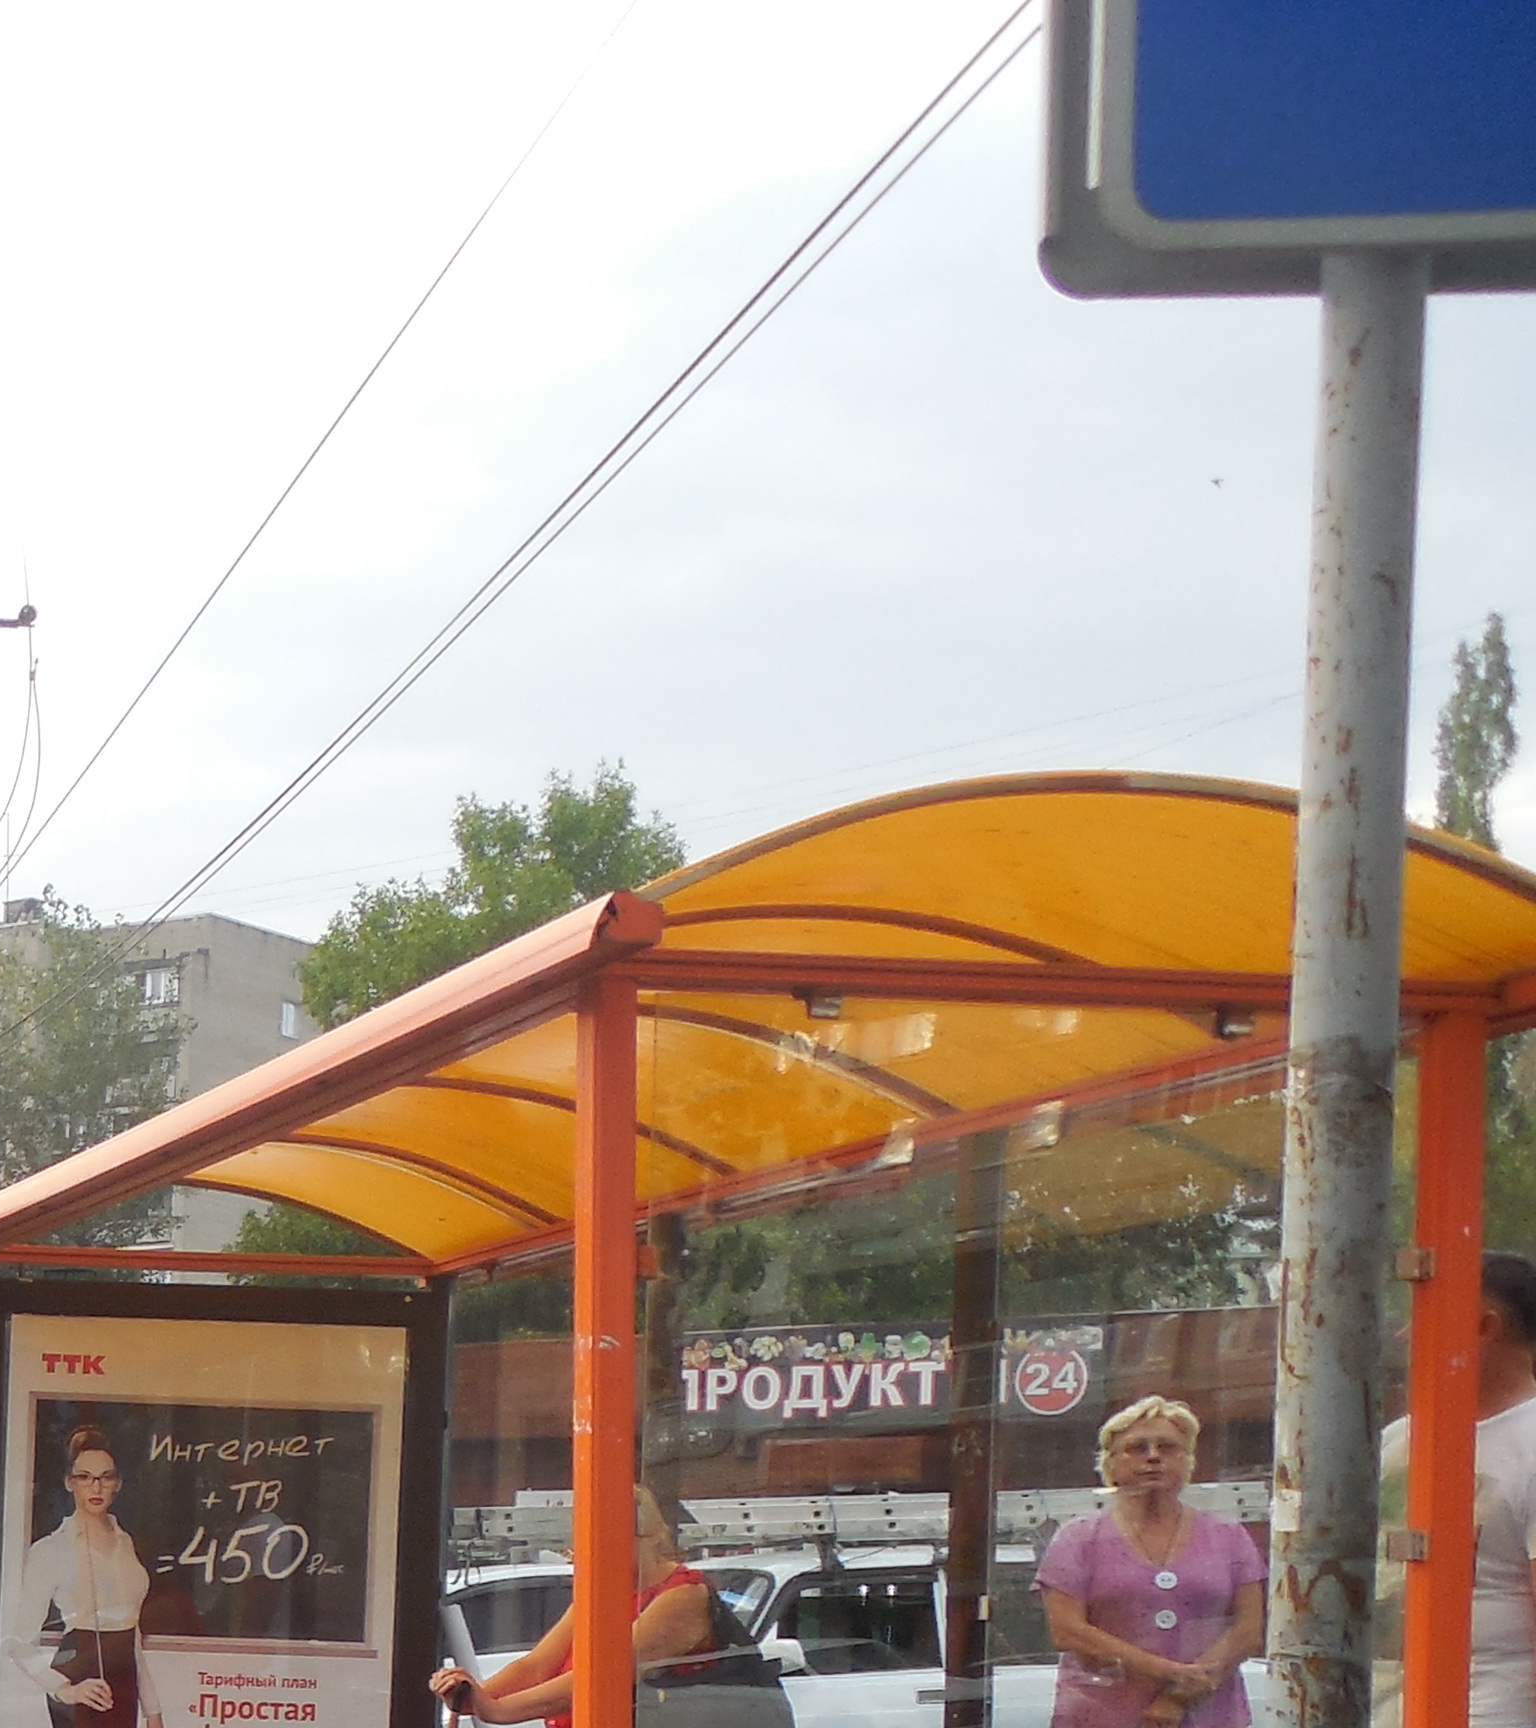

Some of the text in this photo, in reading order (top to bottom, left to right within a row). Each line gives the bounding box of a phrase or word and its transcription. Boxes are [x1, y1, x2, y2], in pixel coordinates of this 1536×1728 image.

[41, 1352, 106, 1375] ТТК
[1025, 1361, 1081, 1398] 24
[148, 1433, 335, 1466] Интернет
[201, 1479, 284, 1514] + ТВ
[197, 1671, 318, 1690] Тарифный план
[188, 1693, 317, 1725] «Простая
